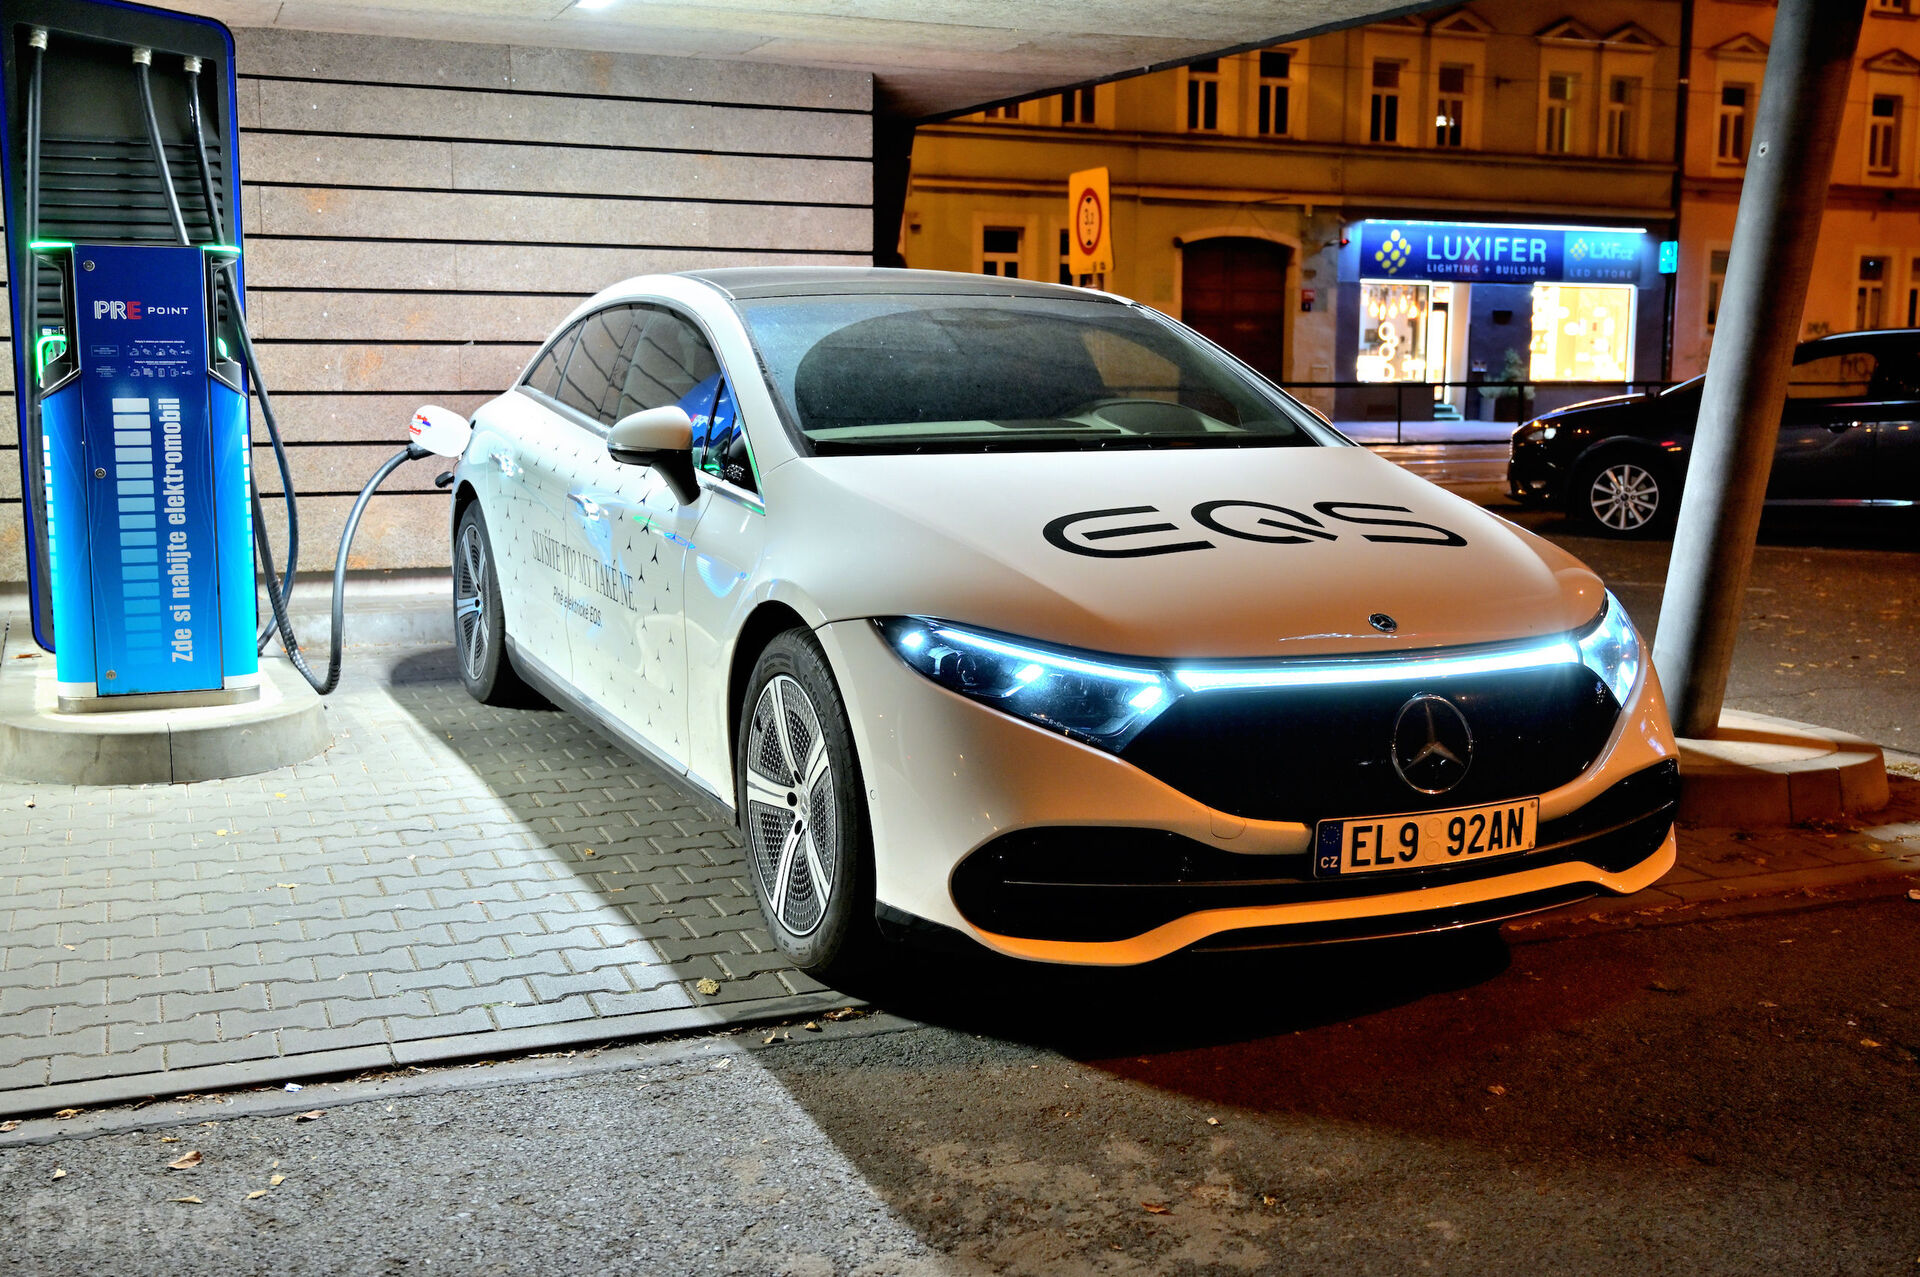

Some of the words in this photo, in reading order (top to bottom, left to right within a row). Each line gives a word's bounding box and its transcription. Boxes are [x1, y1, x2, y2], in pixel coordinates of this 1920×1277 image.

[1427, 235, 1547, 263] LUXIFER
[1427, 264, 1478, 274] LIGHTING
[1496, 265, 1545, 276] BUILDING
[1570, 268, 1591, 278] LED
[1597, 269, 1632, 279] STORE
[94, 300, 142, 320] PRE
[147, 306, 189, 315] POINT
[158, 398, 188, 525] elektromobil
[1042, 500, 1468, 558] EQS
[167, 531, 191, 598] nabijte
[593, 559, 619, 602] TAKÉ
[619, 571, 637, 612] NE.
[169, 604, 191, 621] si
[171, 629, 194, 663] Zde
[1351, 821, 1419, 867] EL9
[1447, 807, 1525, 856] 92AN
[1320, 856, 1338, 869] CZ
